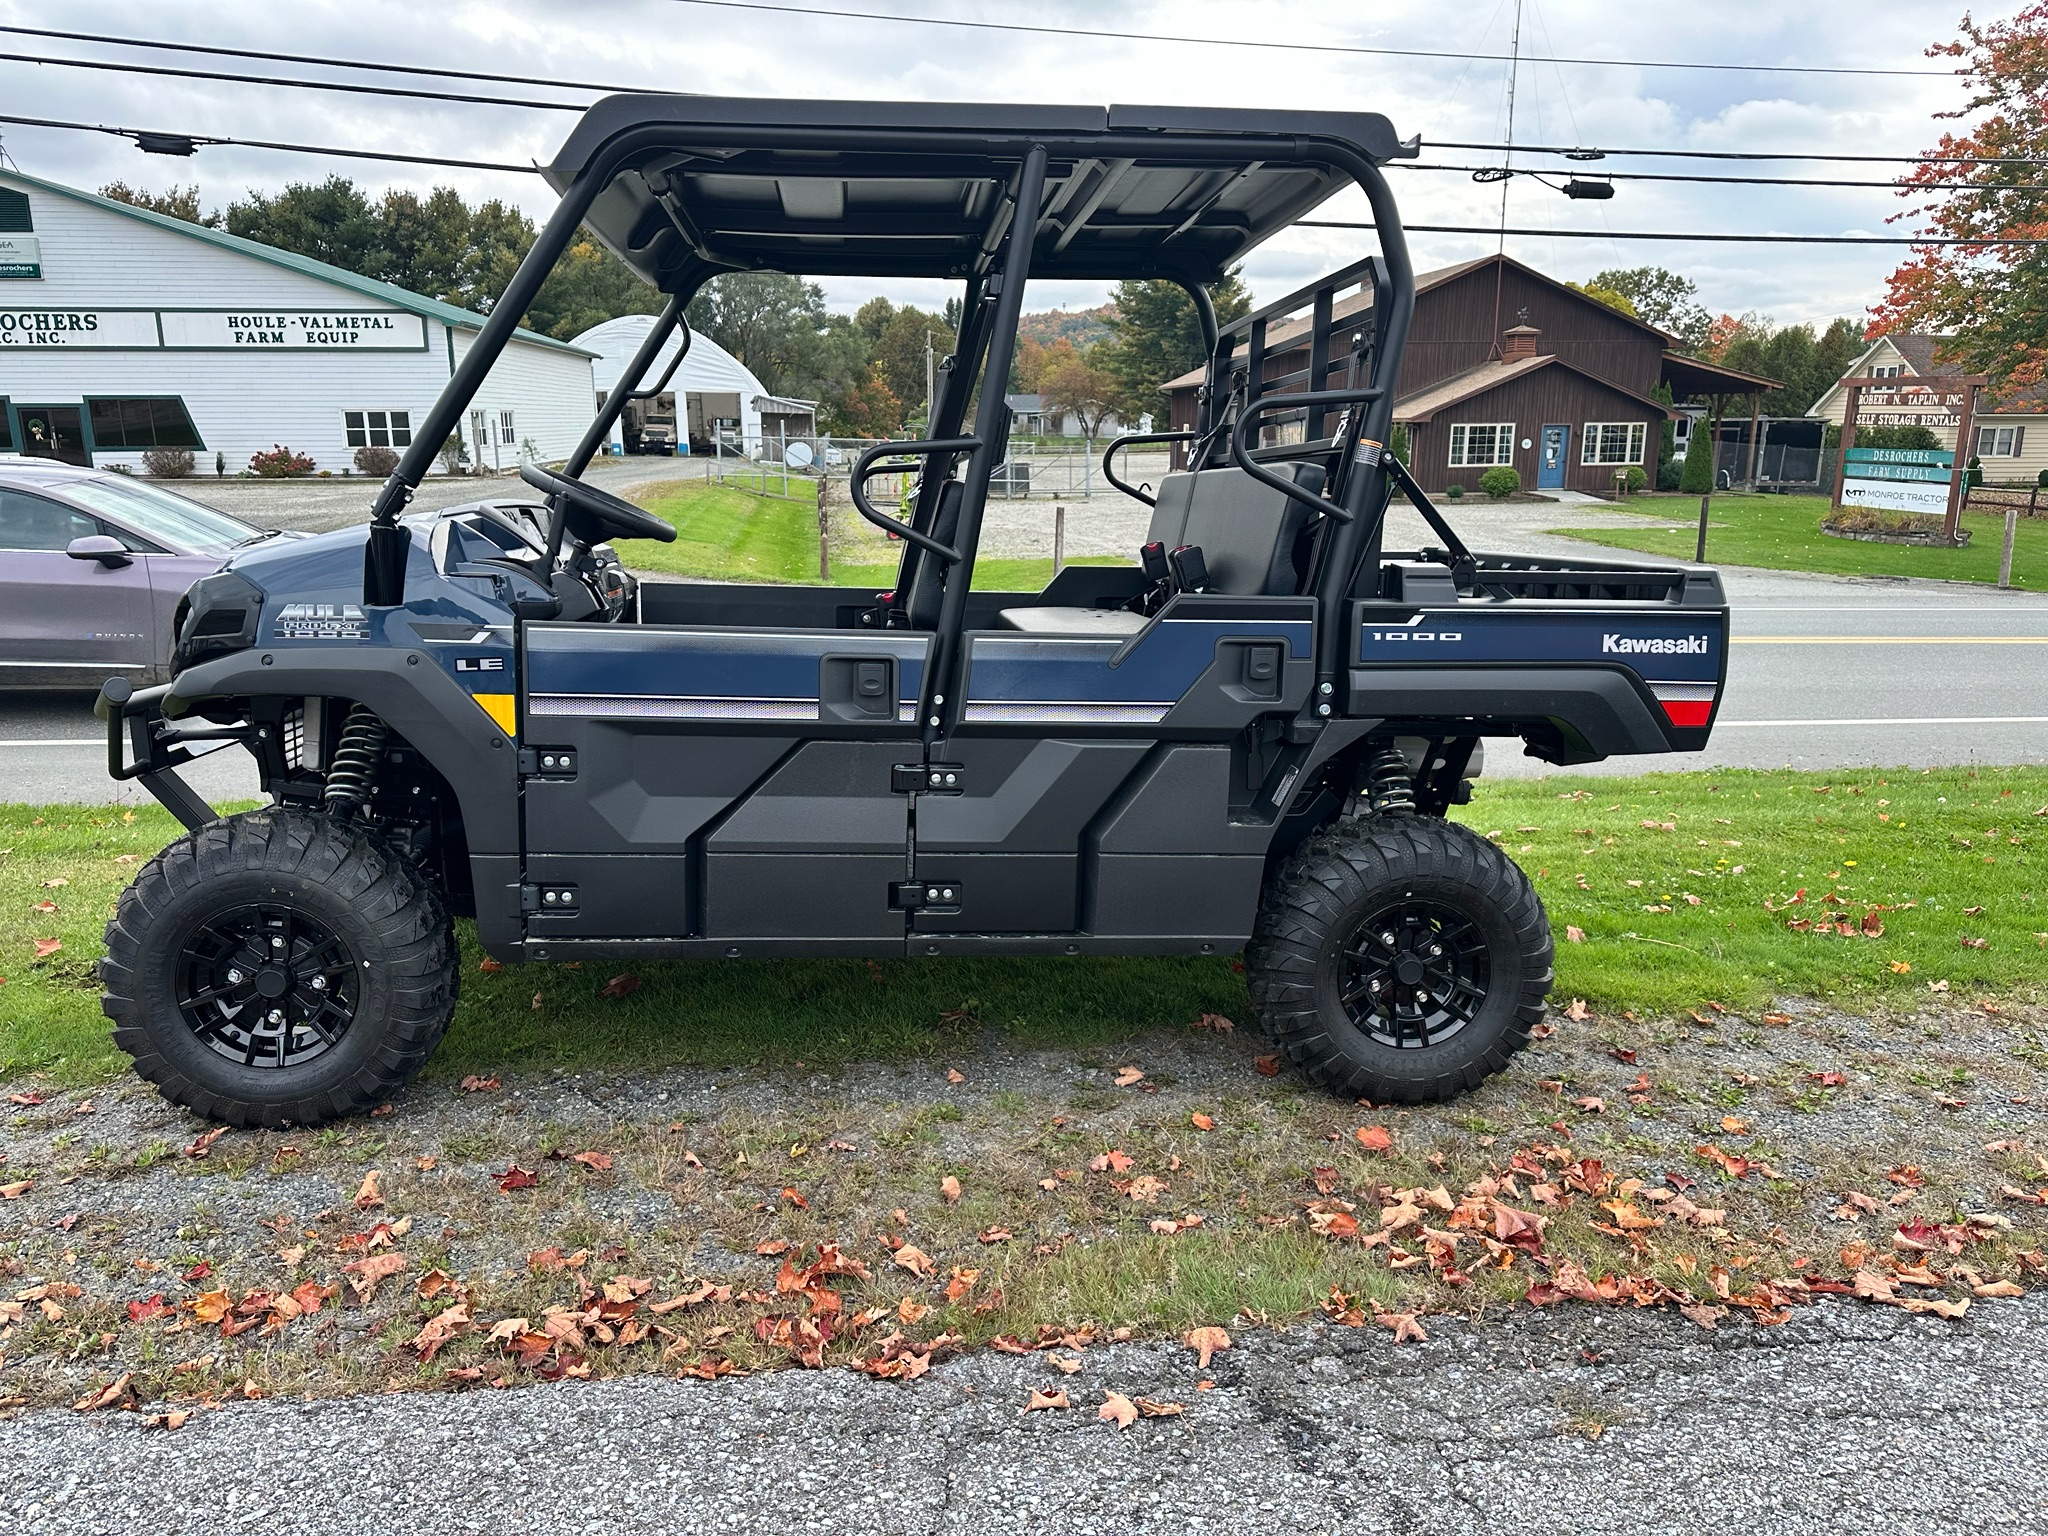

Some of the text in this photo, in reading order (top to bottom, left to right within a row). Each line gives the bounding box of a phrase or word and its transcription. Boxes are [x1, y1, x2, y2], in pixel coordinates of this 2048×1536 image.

[0, 313, 98, 331] OCHERS
[0, 332, 66, 344] C. INC.
[234, 331, 359, 344] FARM EQUIP
[1858, 394, 1965, 406] ROBERT N. TAPLIN INC.
[1856, 414, 1961, 427] SELF STORAGE RENTALS
[1873, 450, 1930, 463] DESROCHERS
[1868, 466, 1931, 480] FARM SUPPLY
[1867, 490, 1905, 500] MONROE
[275, 604, 369, 622] MULE
[1373, 632, 1462, 641] 1000
[1602, 634, 1708, 654] Kawasaki
[456, 658, 504, 671] LE
